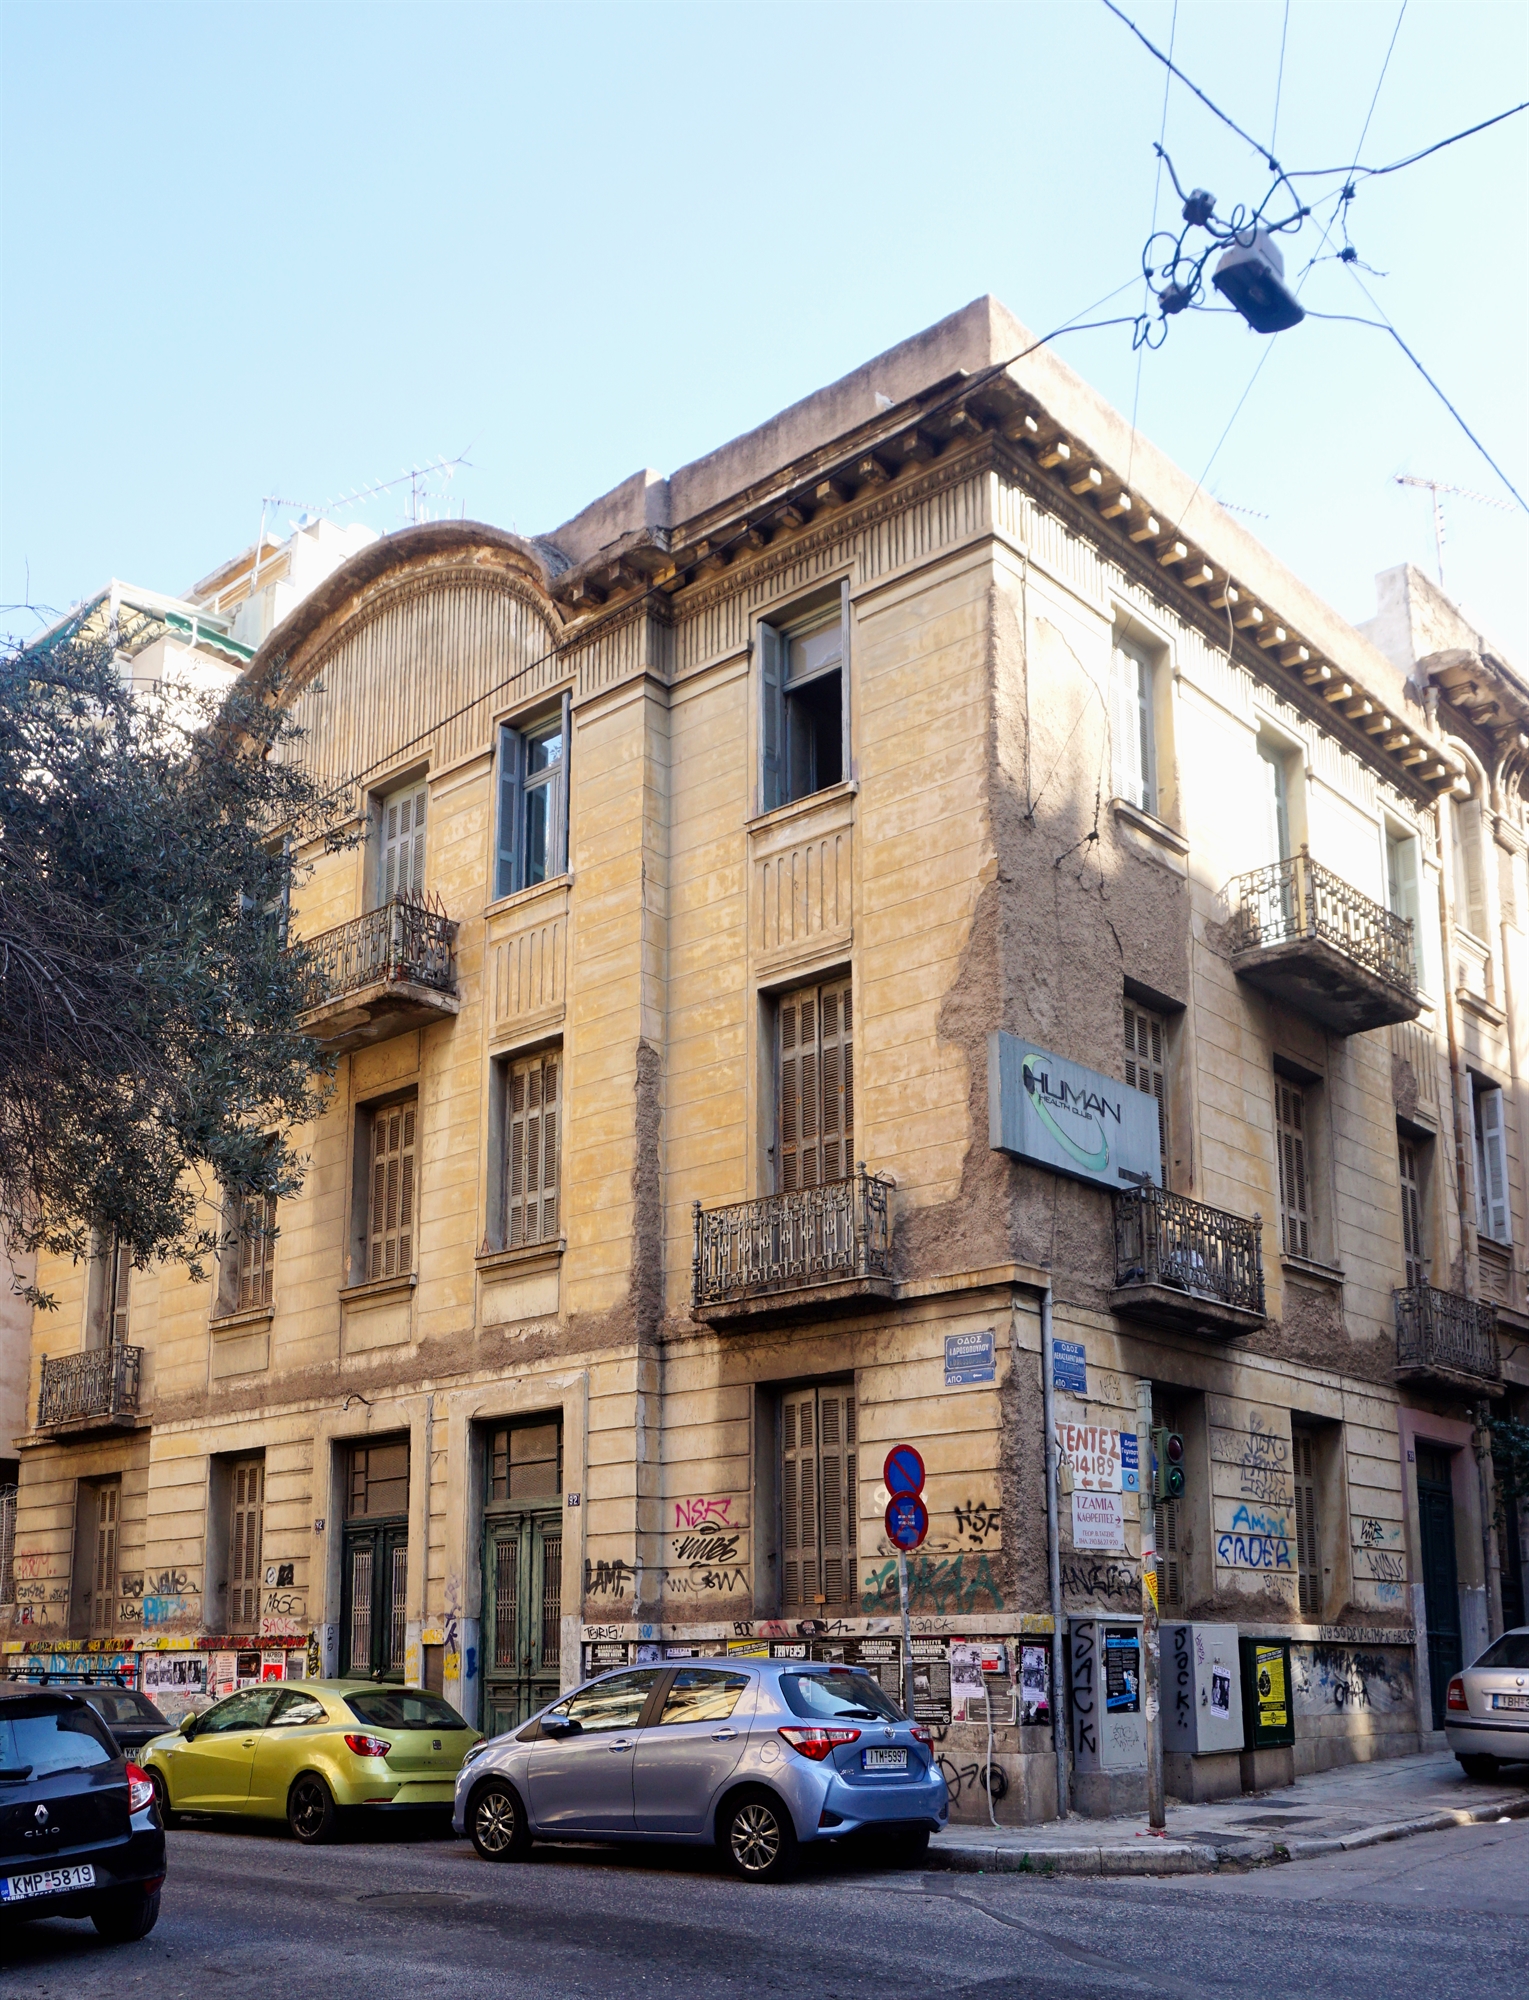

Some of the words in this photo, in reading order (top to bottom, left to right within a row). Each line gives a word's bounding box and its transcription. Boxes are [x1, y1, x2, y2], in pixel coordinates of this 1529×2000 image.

[1023, 1064, 1121, 1124] HUMAN
[1039, 1093, 1070, 1111] HEALTH
[1072, 1107, 1093, 1120] CLUB
[957, 1335, 982, 1345] ΟΔΟΣ
[1061, 1343, 1079, 1353] ΟΔΟΣ
[947, 1375, 962, 1384] ΑΠΟ
[1055, 1424, 1120, 1460] ΤΕΝΤΕΣ
[1075, 1496, 1114, 1511] ΤΖΑΜΙΑ
[915, 1617, 952, 1632] SACK
[1073, 1622, 1095, 1753] SACK
[24, 1827, 60, 1837] CLIO
